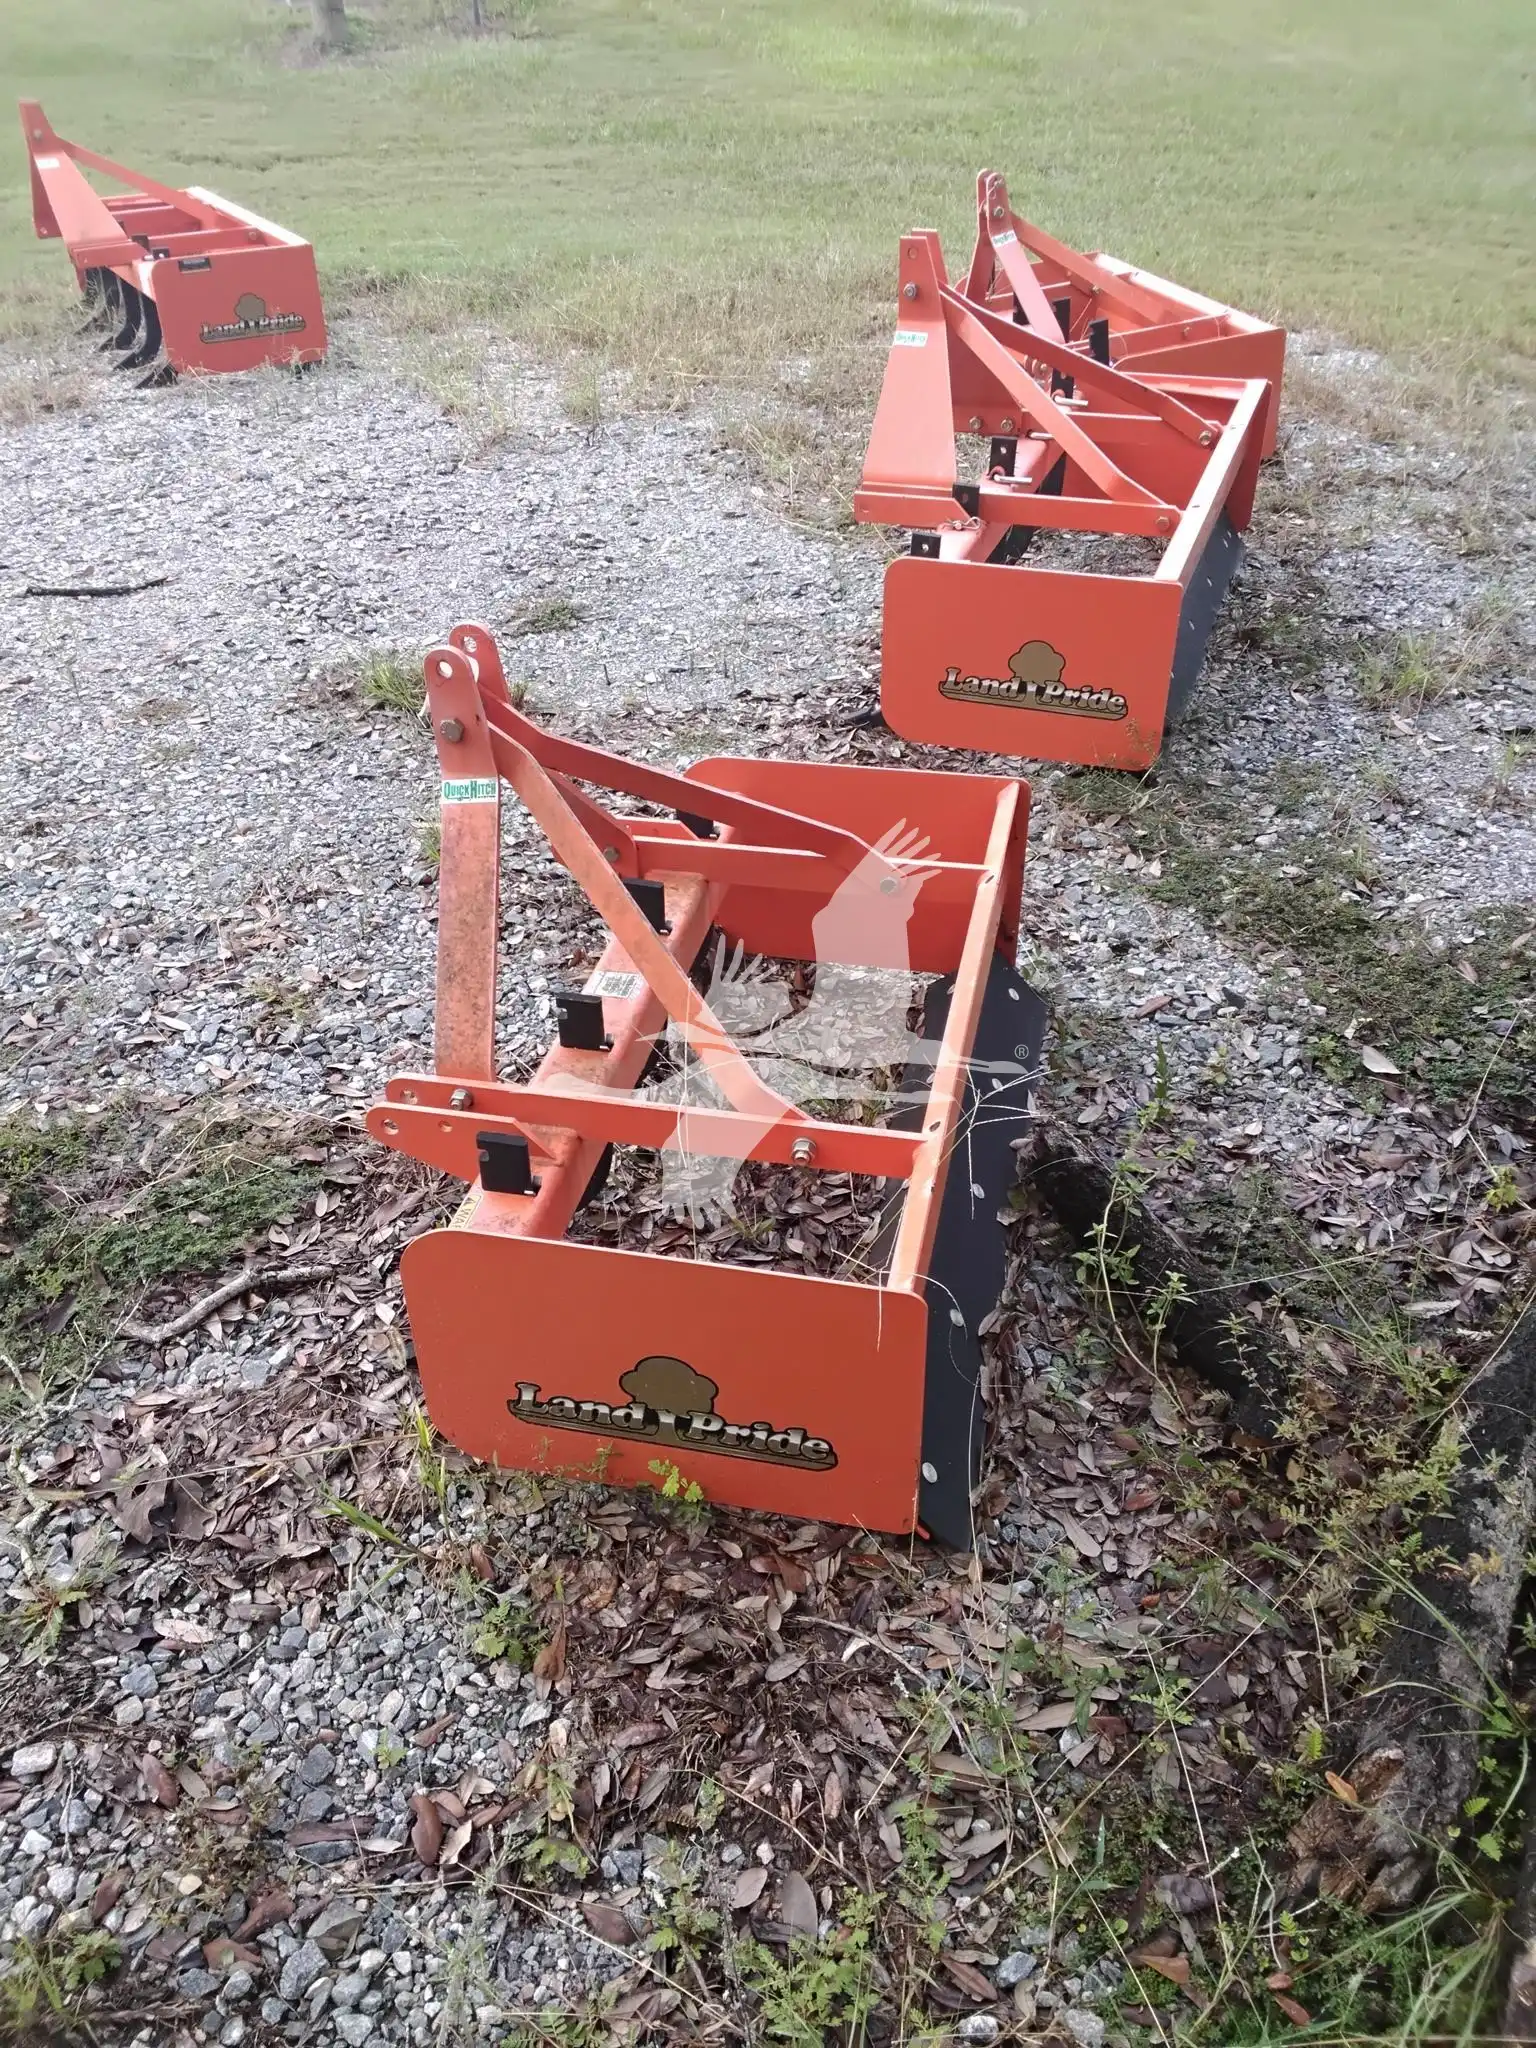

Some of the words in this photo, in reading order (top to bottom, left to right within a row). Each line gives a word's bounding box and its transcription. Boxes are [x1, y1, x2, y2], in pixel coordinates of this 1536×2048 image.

[203, 319, 246, 338] Land
[259, 313, 304, 331] Pride
[944, 667, 1021, 698] Land
[1041, 681, 1126, 712] Pride
[515, 1382, 649, 1431] Land
[682, 1410, 833, 1460] Pride
